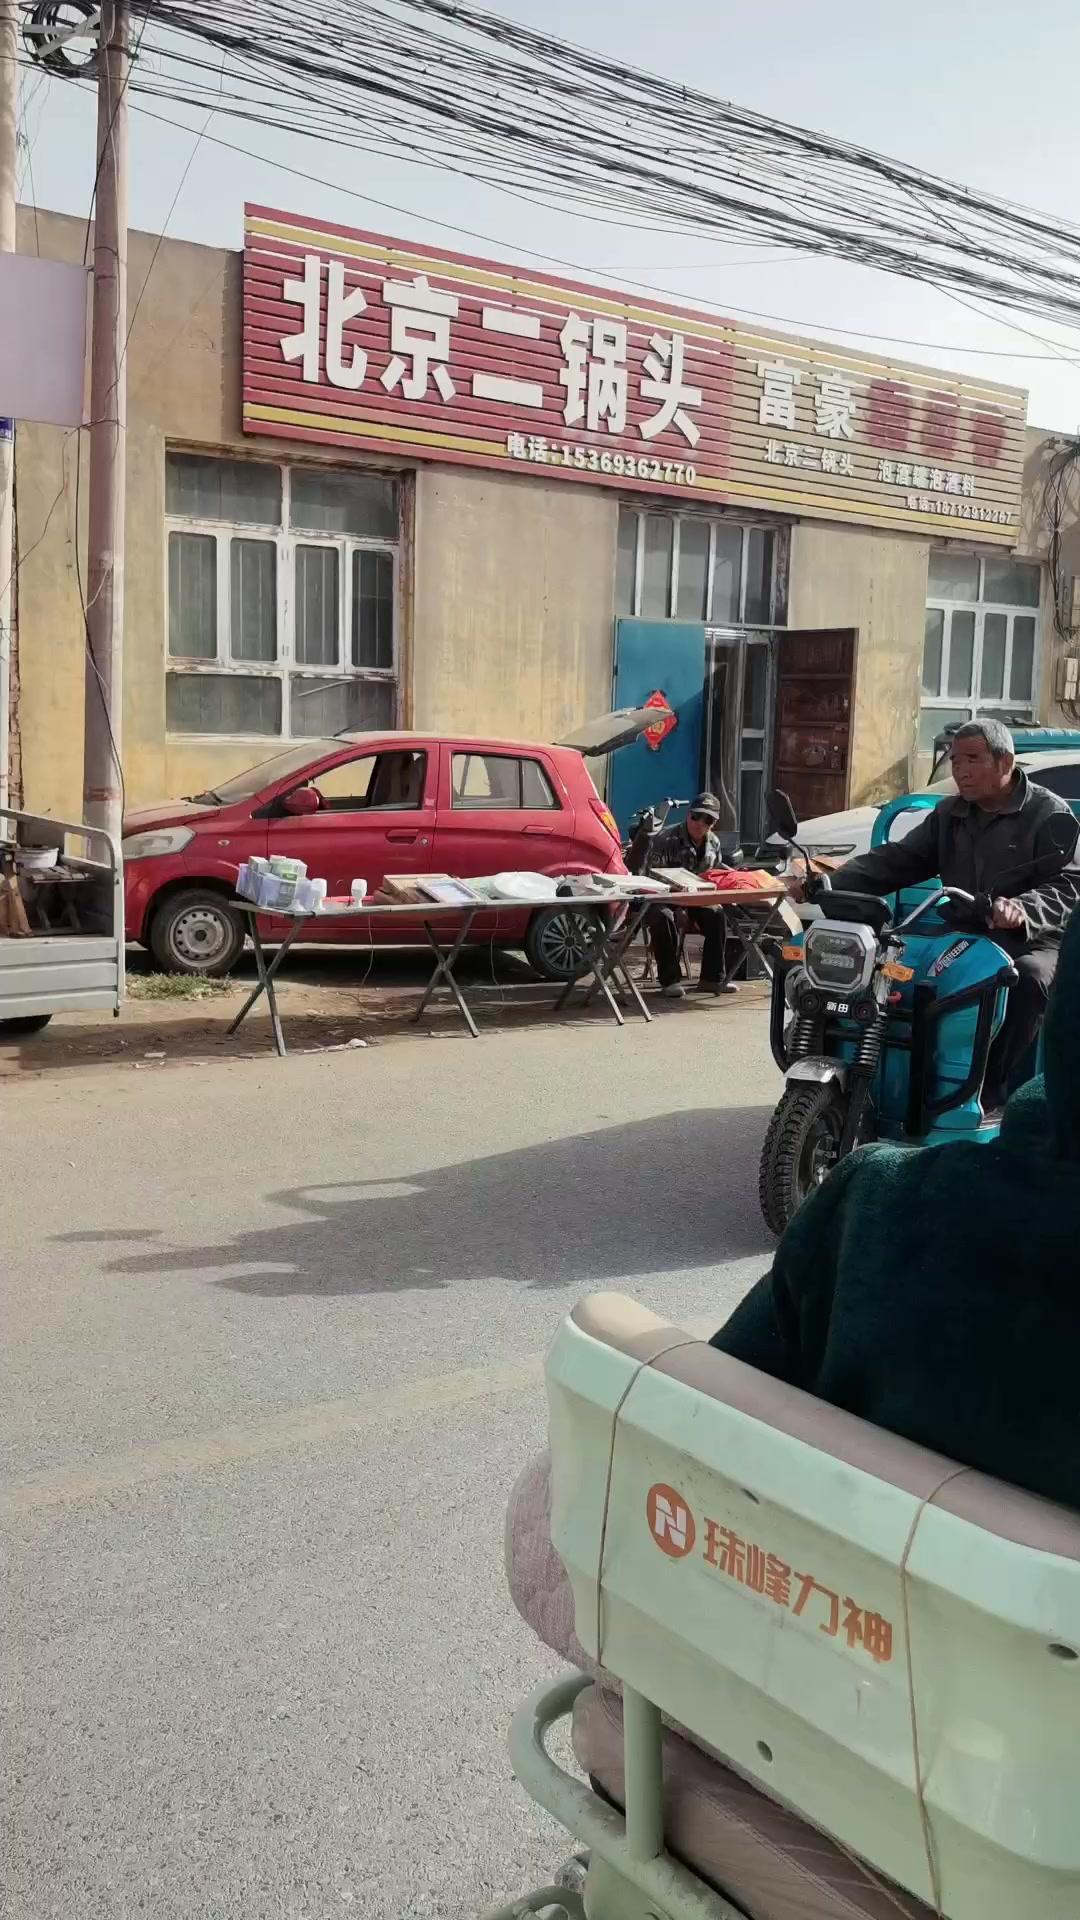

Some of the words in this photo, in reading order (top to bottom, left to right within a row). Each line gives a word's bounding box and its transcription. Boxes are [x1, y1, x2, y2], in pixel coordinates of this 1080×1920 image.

[280, 254, 702, 448] 北京二锅头
[757, 359, 857, 440] 富豪
[763, 439, 854, 477] 北京二锅头
[703, 1516, 893, 1664] 珠峰力神
